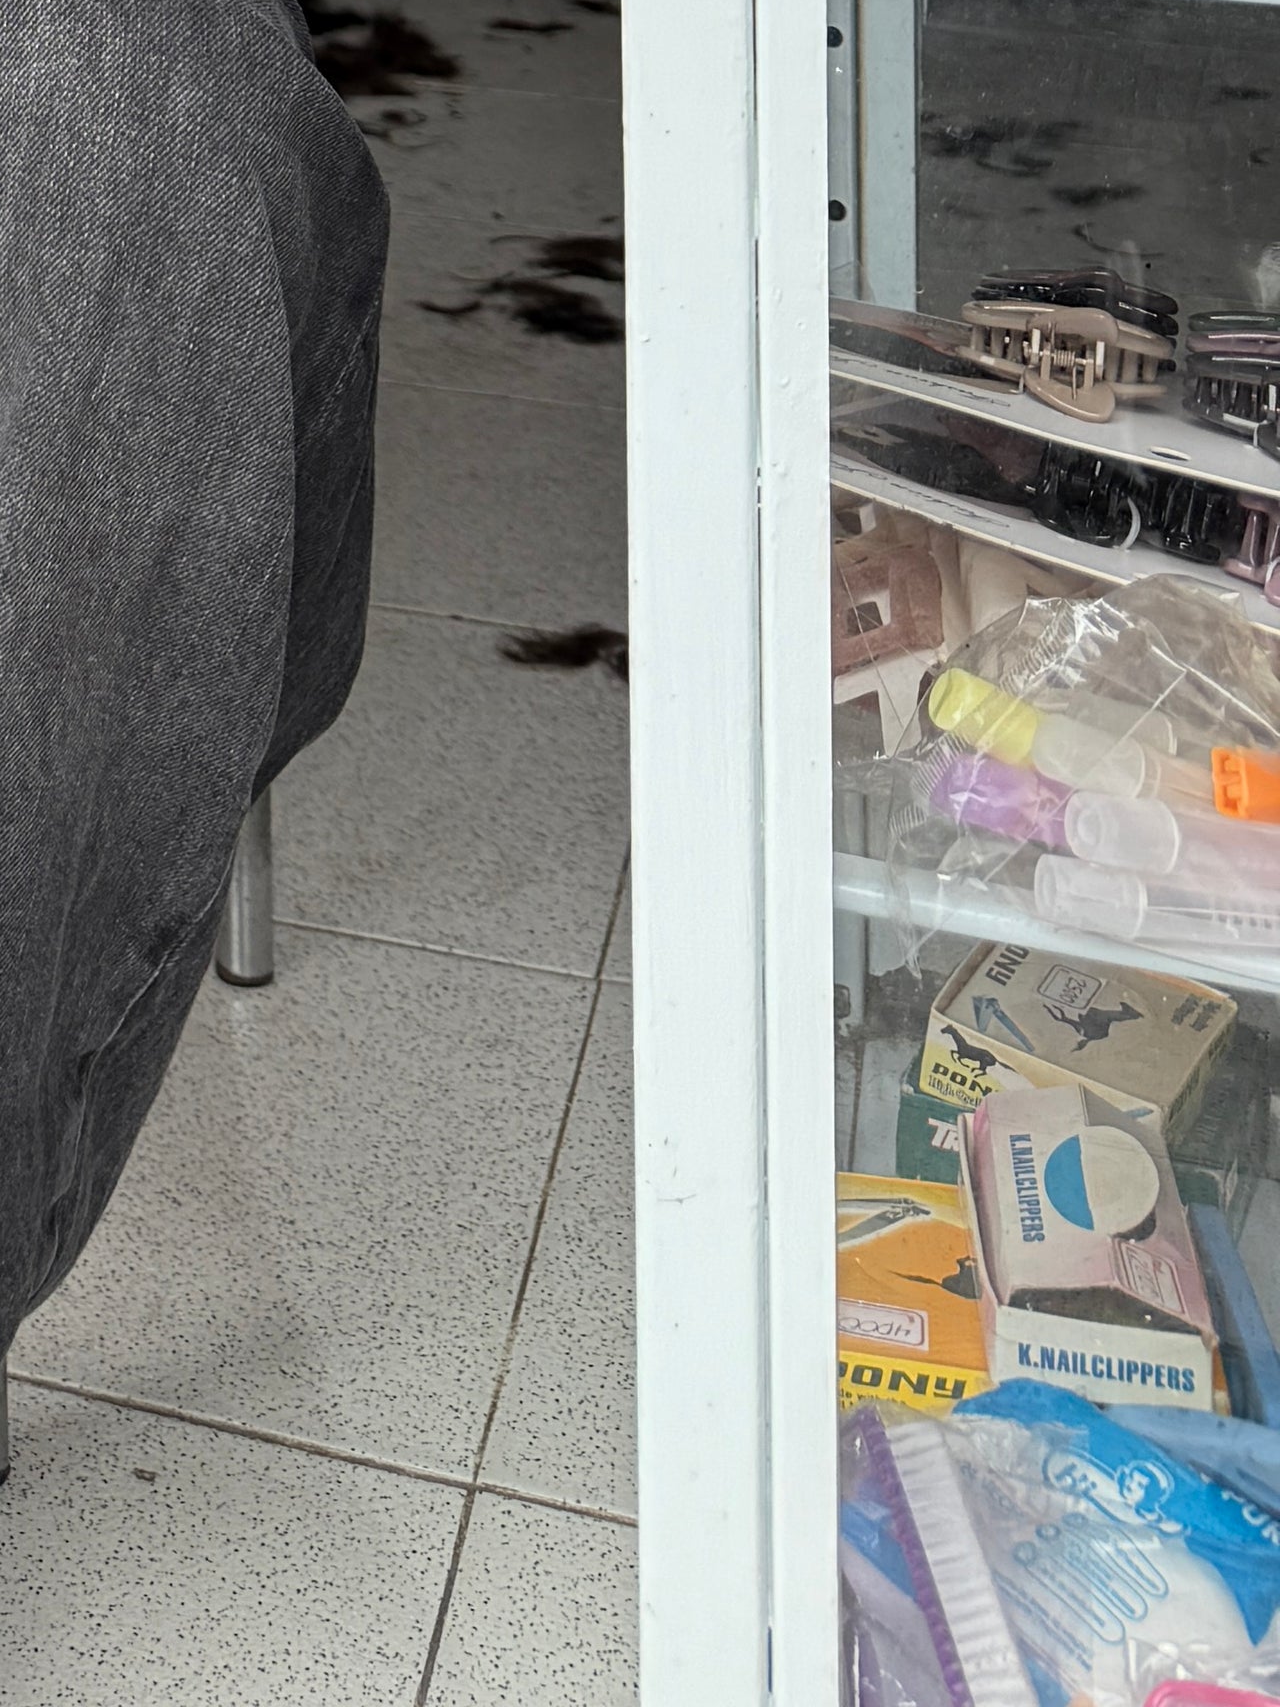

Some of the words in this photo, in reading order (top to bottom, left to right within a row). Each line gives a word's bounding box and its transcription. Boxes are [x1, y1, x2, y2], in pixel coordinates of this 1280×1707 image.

[986, 943, 1030, 987] ONY
[931, 1062, 996, 1097] PON
[1018, 1342, 1195, 1392] K.NAILCLIPPERS
